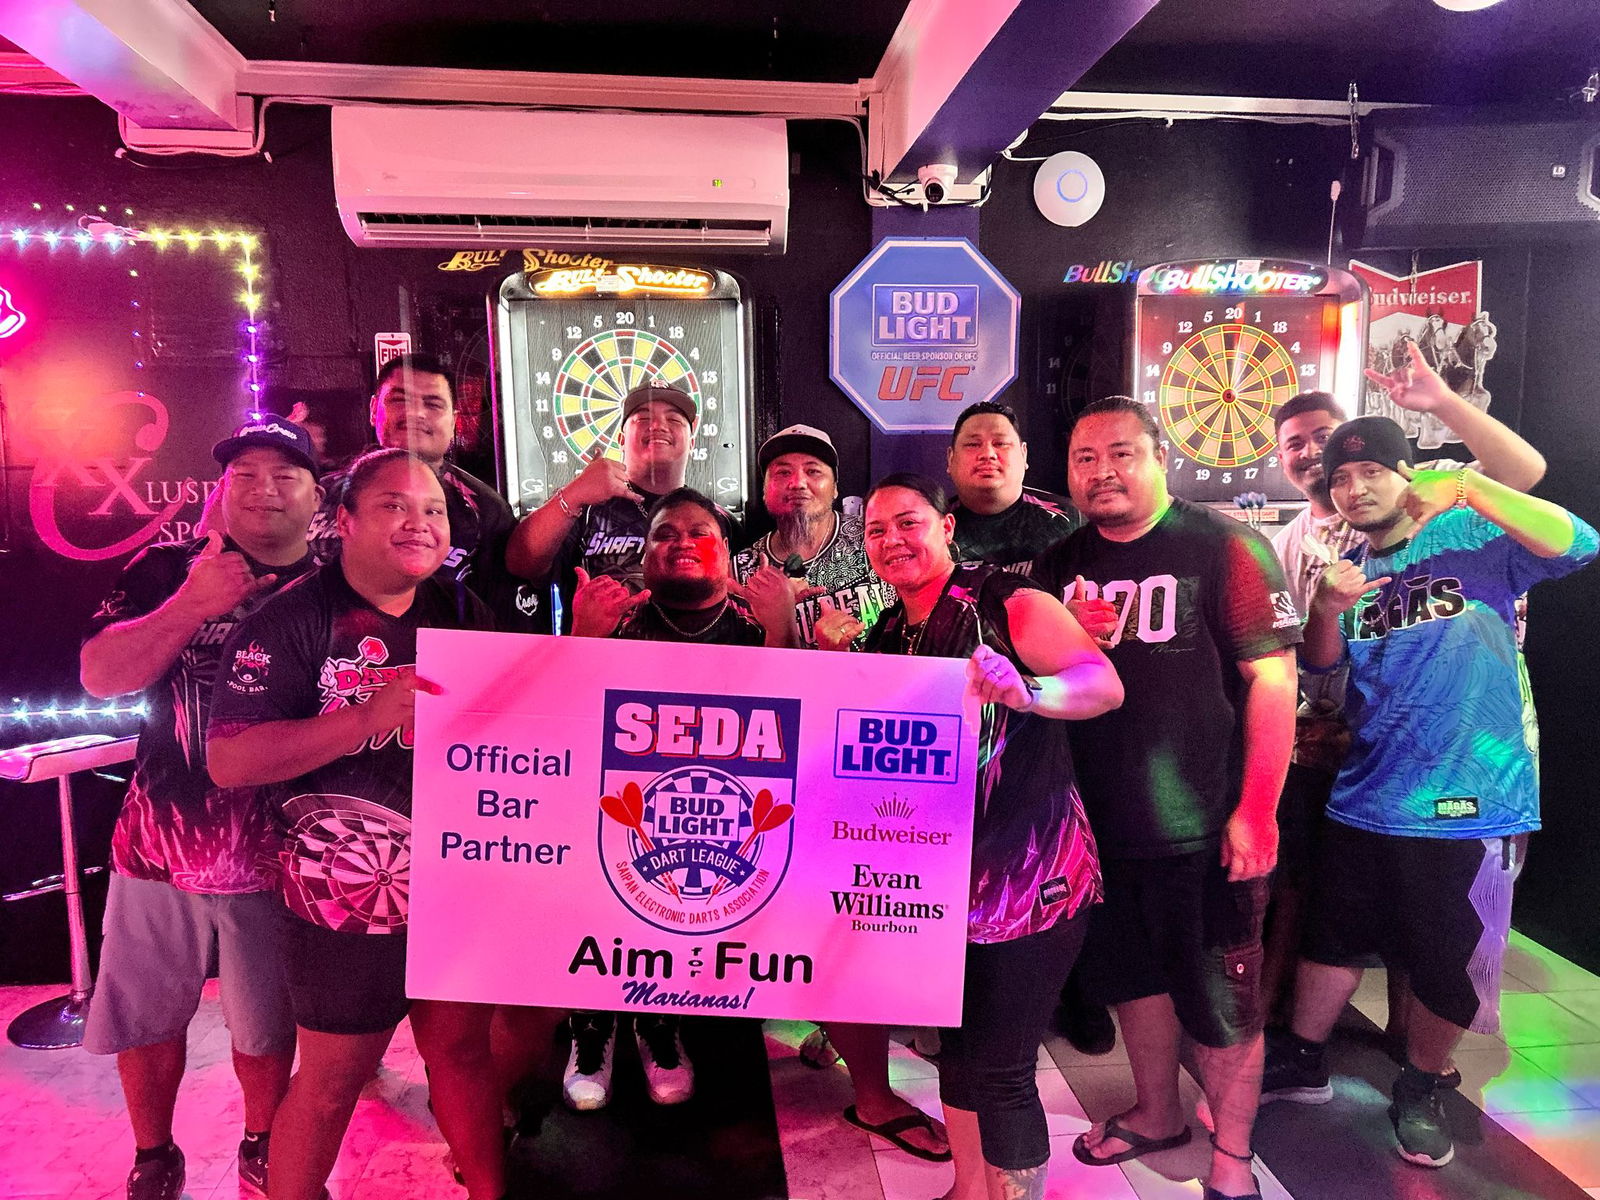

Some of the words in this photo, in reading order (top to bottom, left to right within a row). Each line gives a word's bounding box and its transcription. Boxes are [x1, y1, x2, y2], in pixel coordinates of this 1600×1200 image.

[616, 266, 708, 293] Shooter
[891, 291, 959, 315] BUD
[615, 312, 635, 325] 20
[1203, 311, 1213, 323] 5
[1225, 307, 1243, 319] 20
[1254, 311, 1262, 323] 1
[594, 315, 603, 329] 5
[648, 315, 655, 328] 1
[878, 316, 972, 340] LIGHT
[1177, 321, 1193, 333] 12
[1272, 321, 1288, 333] 18
[566, 326, 582, 339] 12
[668, 326, 684, 339] 18
[552, 347, 562, 361] 9
[690, 347, 700, 360] 4
[1162, 342, 1172, 354] 9
[1290, 342, 1300, 353] 4
[871, 351, 902, 361] OFFICIAL
[903, 351, 920, 361] BEER
[954, 351, 964, 361] OF
[964, 351, 978, 361] UFC
[1145, 364, 1160, 377] 14
[535, 371, 551, 385] 14
[877, 366, 970, 401] UFC
[706, 397, 717, 410] 6
[1143, 391, 1156, 403] 11
[535, 399, 549, 412] 11
[542, 425, 553, 439] 8
[702, 423, 718, 436] 10
[552, 450, 568, 463] 16
[1268, 457, 1278, 467] 2
[1174, 458, 1184, 470] 7
[1195, 469, 1210, 480] 19
[1221, 472, 1232, 484] 3
[1244, 468, 1259, 479] 17
[235, 650, 271, 663] BLACK
[334, 666, 400, 691] DAR
[614, 702, 785, 761] SEDA
[859, 717, 938, 747] BUD
[446, 743, 571, 777] Official
[477, 789, 539, 819] Bar
[670, 797, 725, 816] BUD
[658, 815, 735, 836] LIGHT
[832, 820, 952, 845] Budweiser
[441, 831, 571, 865] Partner
[650, 848, 686, 871] DART
[691, 848, 741, 875] LEAGUE
[851, 863, 922, 889] Evan
[616, 861, 640, 895] SAIPAN
[635, 890, 686, 924] ELECTRONIC
[689, 909, 721, 924] DARTS
[723, 868, 771, 918] ASSOCIATION
[829, 890, 944, 920] Williams
[851, 919, 918, 934] Bourbon
[568, 935, 673, 979] Aim
[688, 946, 704, 978] for
[715, 941, 813, 984] Fun
[622, 980, 755, 1009] Marianas!
